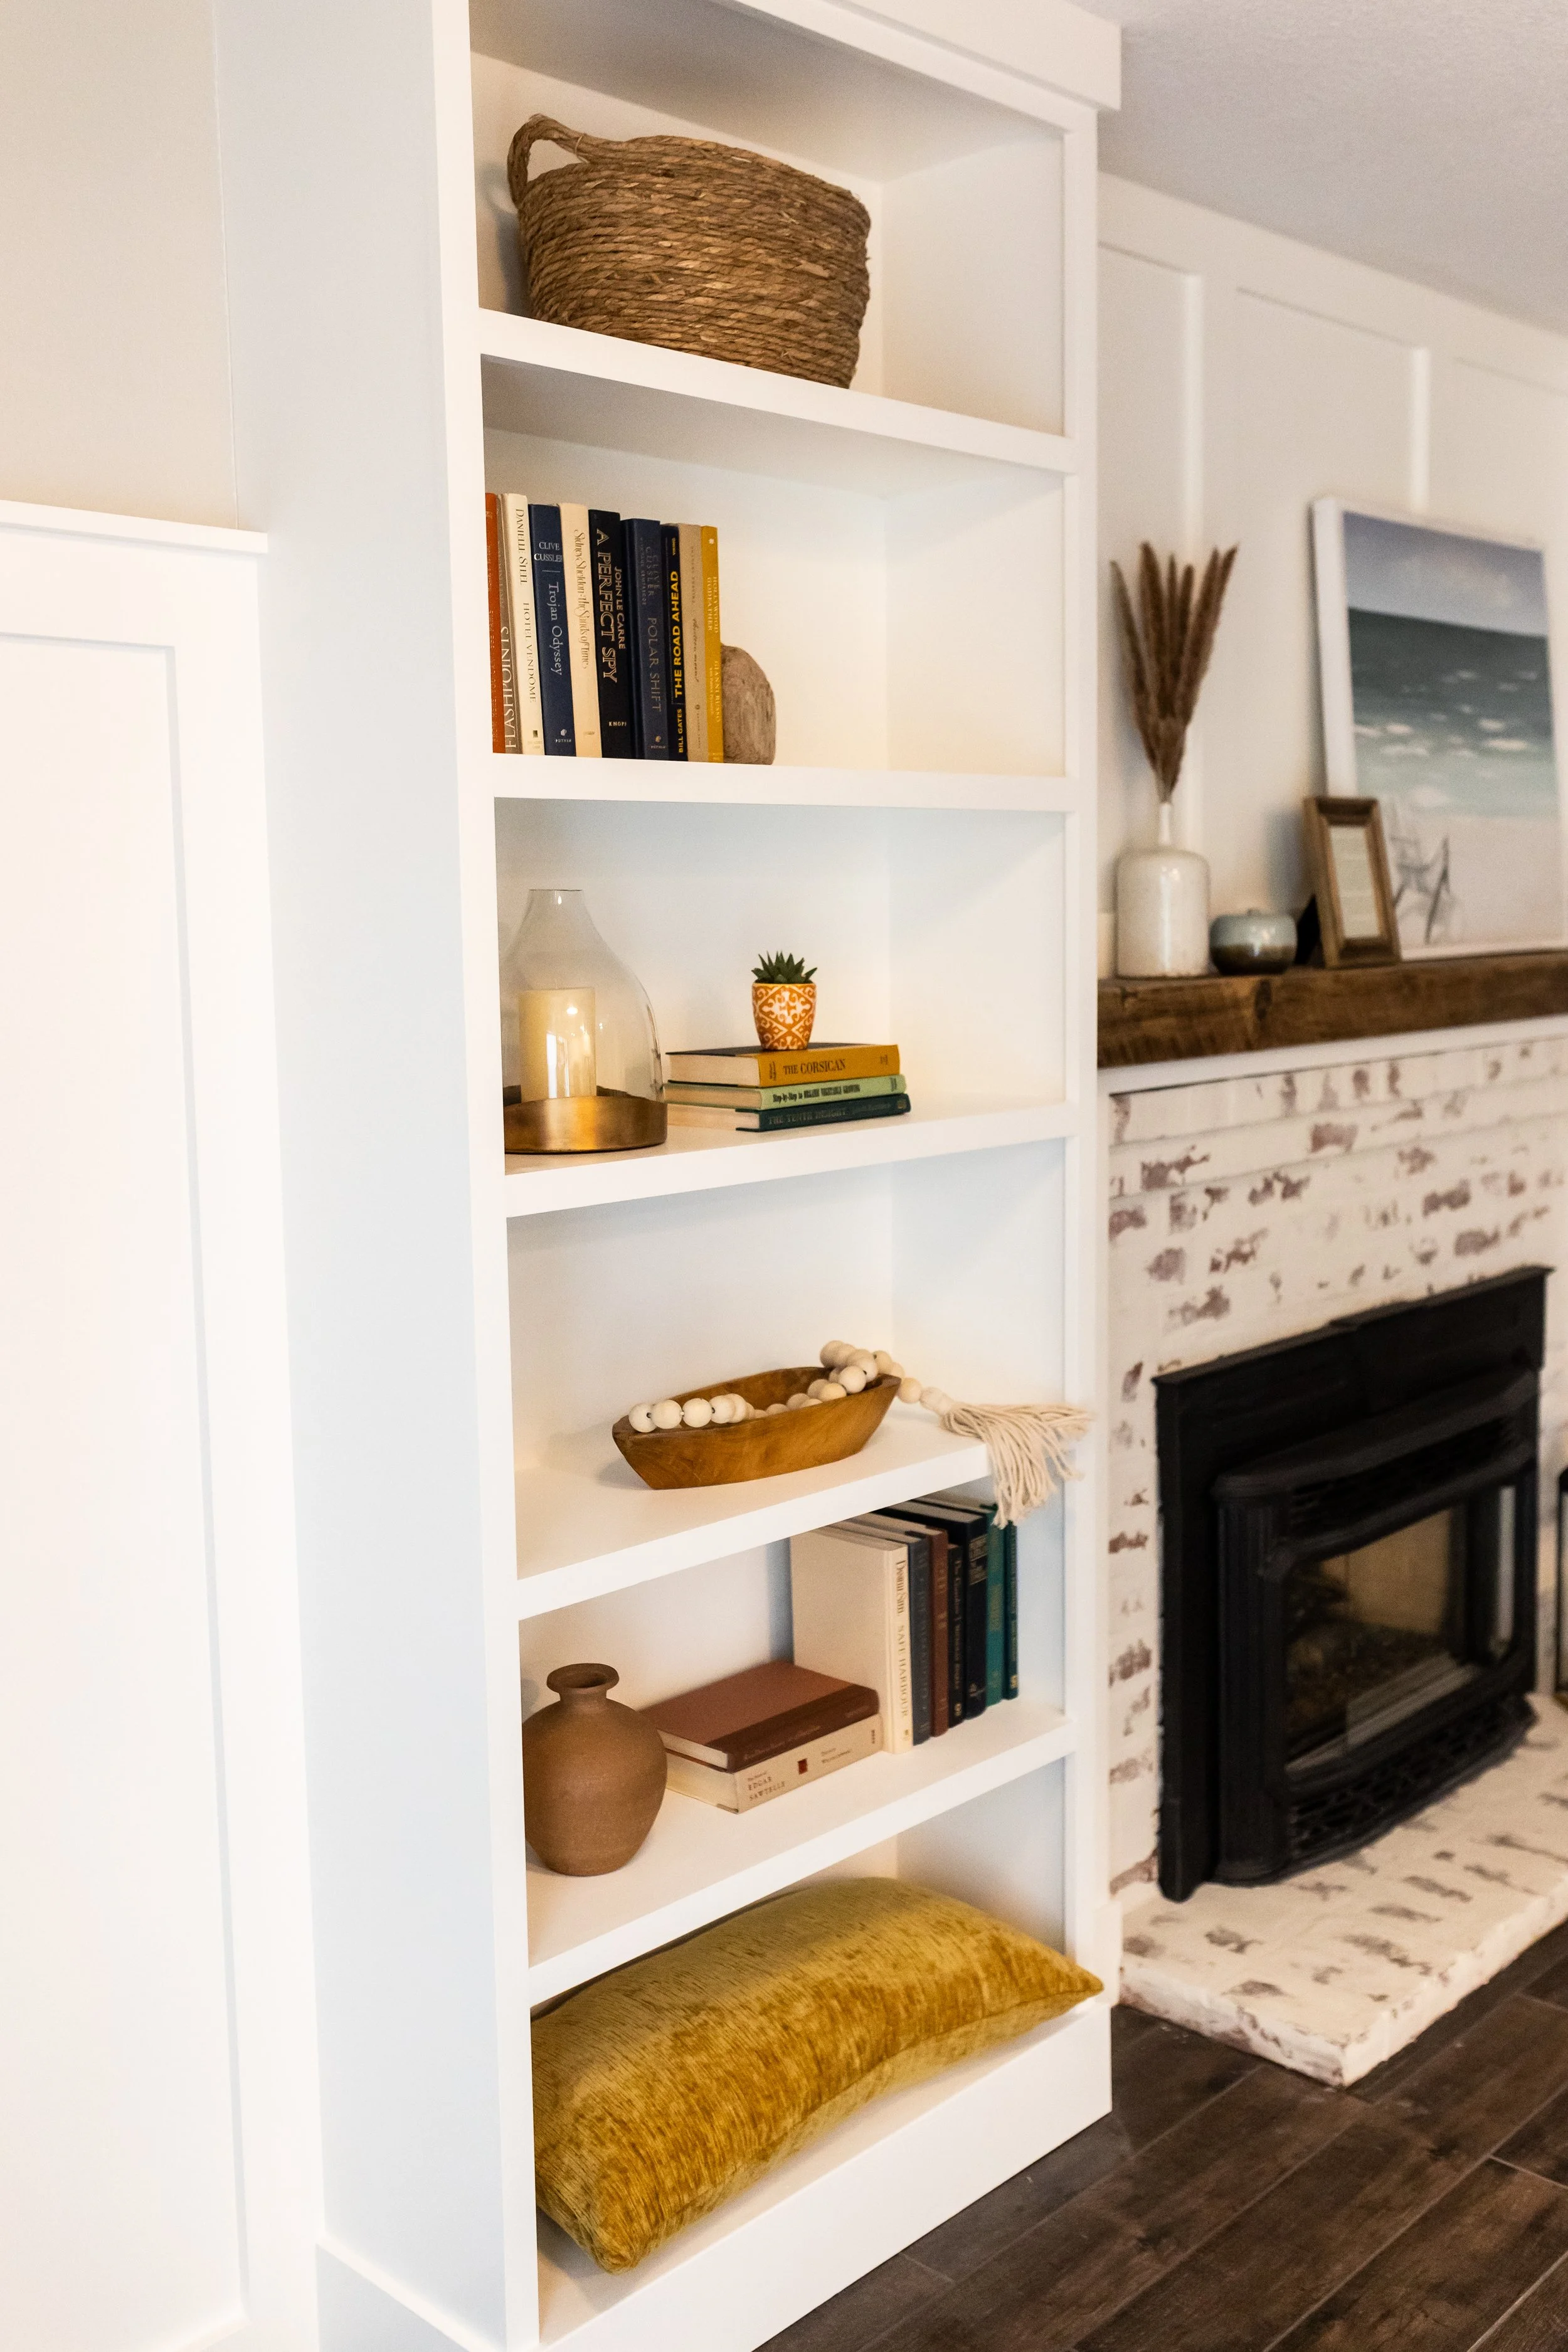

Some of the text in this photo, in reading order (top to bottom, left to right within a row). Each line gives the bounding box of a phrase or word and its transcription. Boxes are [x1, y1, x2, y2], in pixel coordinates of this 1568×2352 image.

[516, 508, 529, 585] DANIELLE STEEL
[539, 541, 560, 551] CLIVE
[573, 529, 586, 558] Sidney
[575, 556, 588, 594] Sheldon
[615, 566, 623, 598] JOHN
[545, 581, 564, 675] Trojan Odyssey
[596, 528, 617, 683] A PERFECT SPY
[616, 599, 624, 611] LE
[670, 571, 684, 698] THE ROAD AHEAD
[500, 626, 516, 748] FLASHPOINTS
[522, 602, 537, 703] HOTEL VENDÔME
[647, 617, 662, 712] POLAR SHIFT
[783, 1064, 798, 1075] THE
[800, 1058, 846, 1074] CORSICAN
